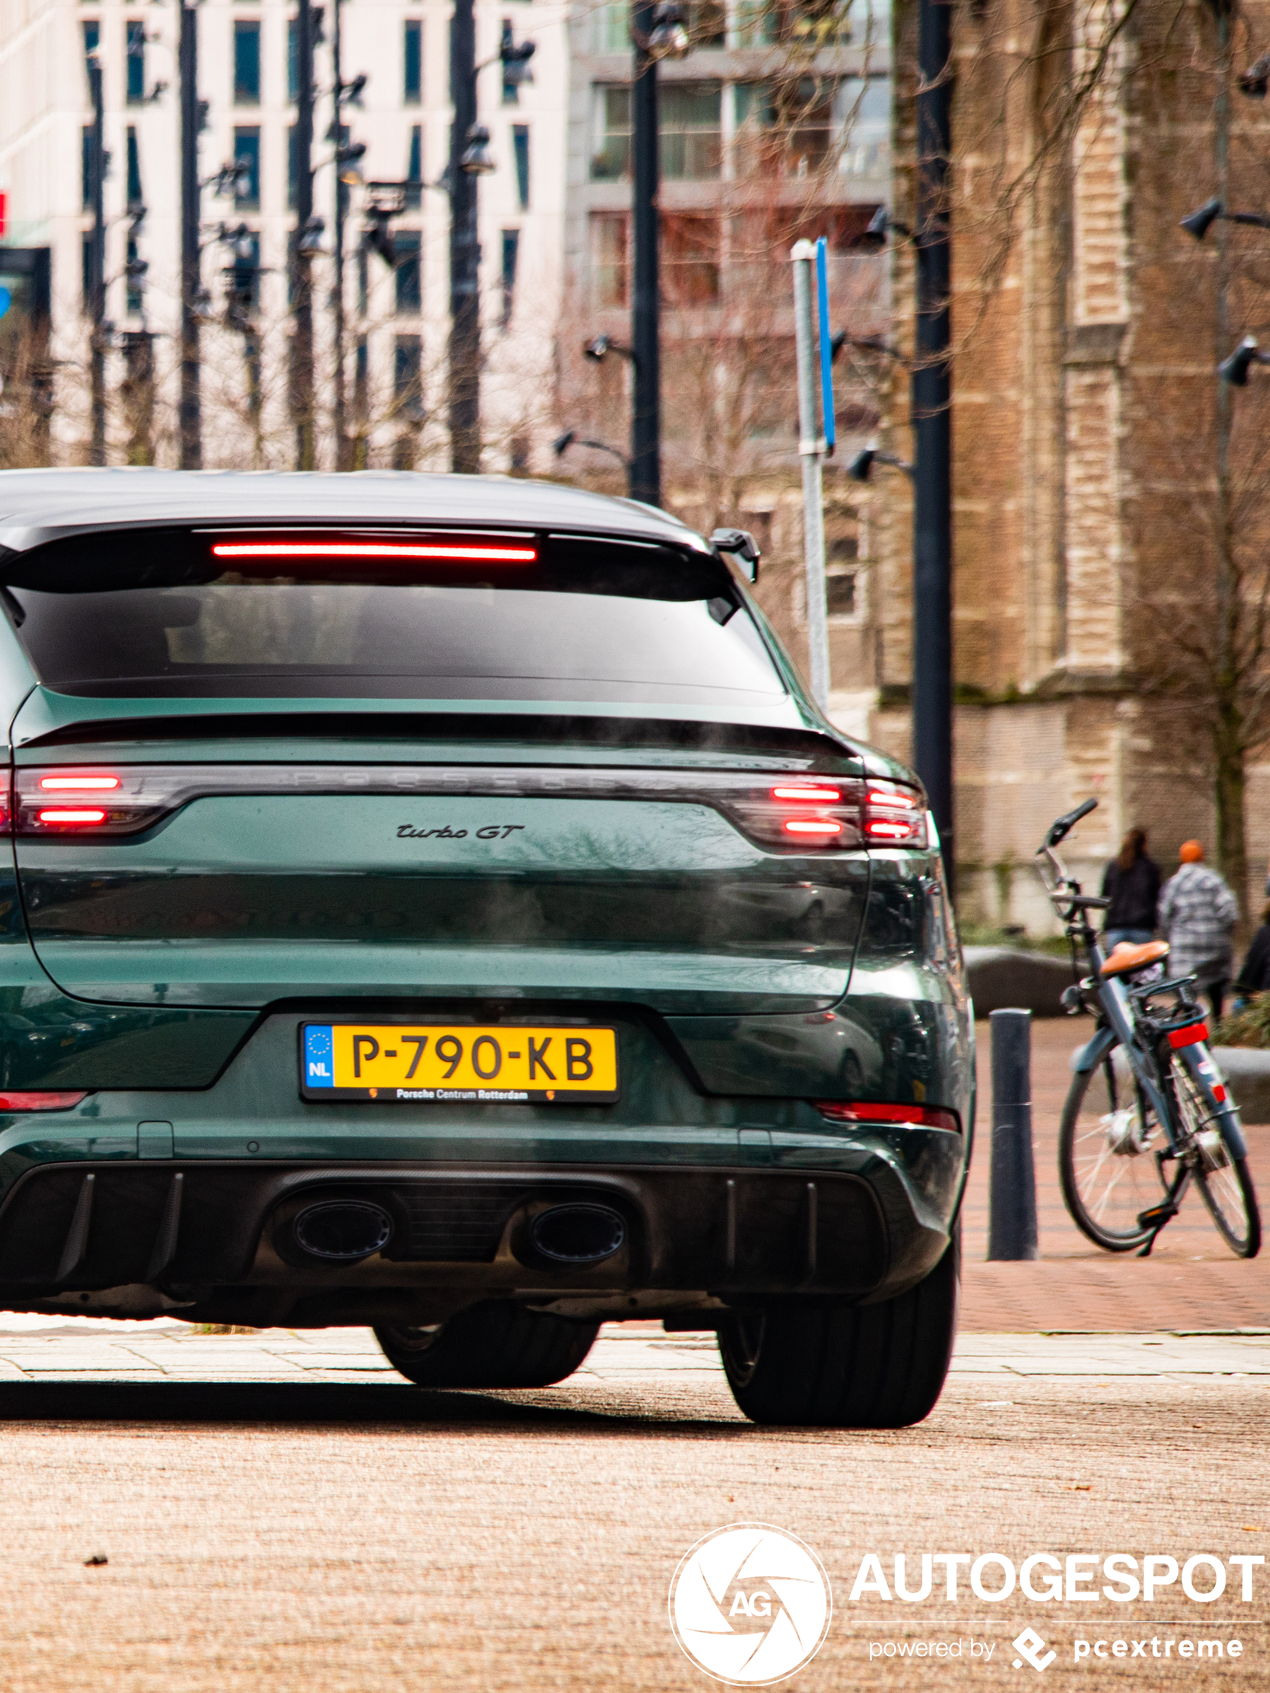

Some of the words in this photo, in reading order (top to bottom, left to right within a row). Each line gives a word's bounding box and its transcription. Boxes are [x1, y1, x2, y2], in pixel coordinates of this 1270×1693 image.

[396, 823, 468, 839] turbo
[476, 825, 526, 839] GT
[352, 1034, 594, 1081] P-790-KB
[309, 1063, 330, 1077] NL
[396, 1089, 435, 1099] Porsche
[436, 1089, 476, 1099] Centrum
[478, 1090, 528, 1100] Rotterdam
